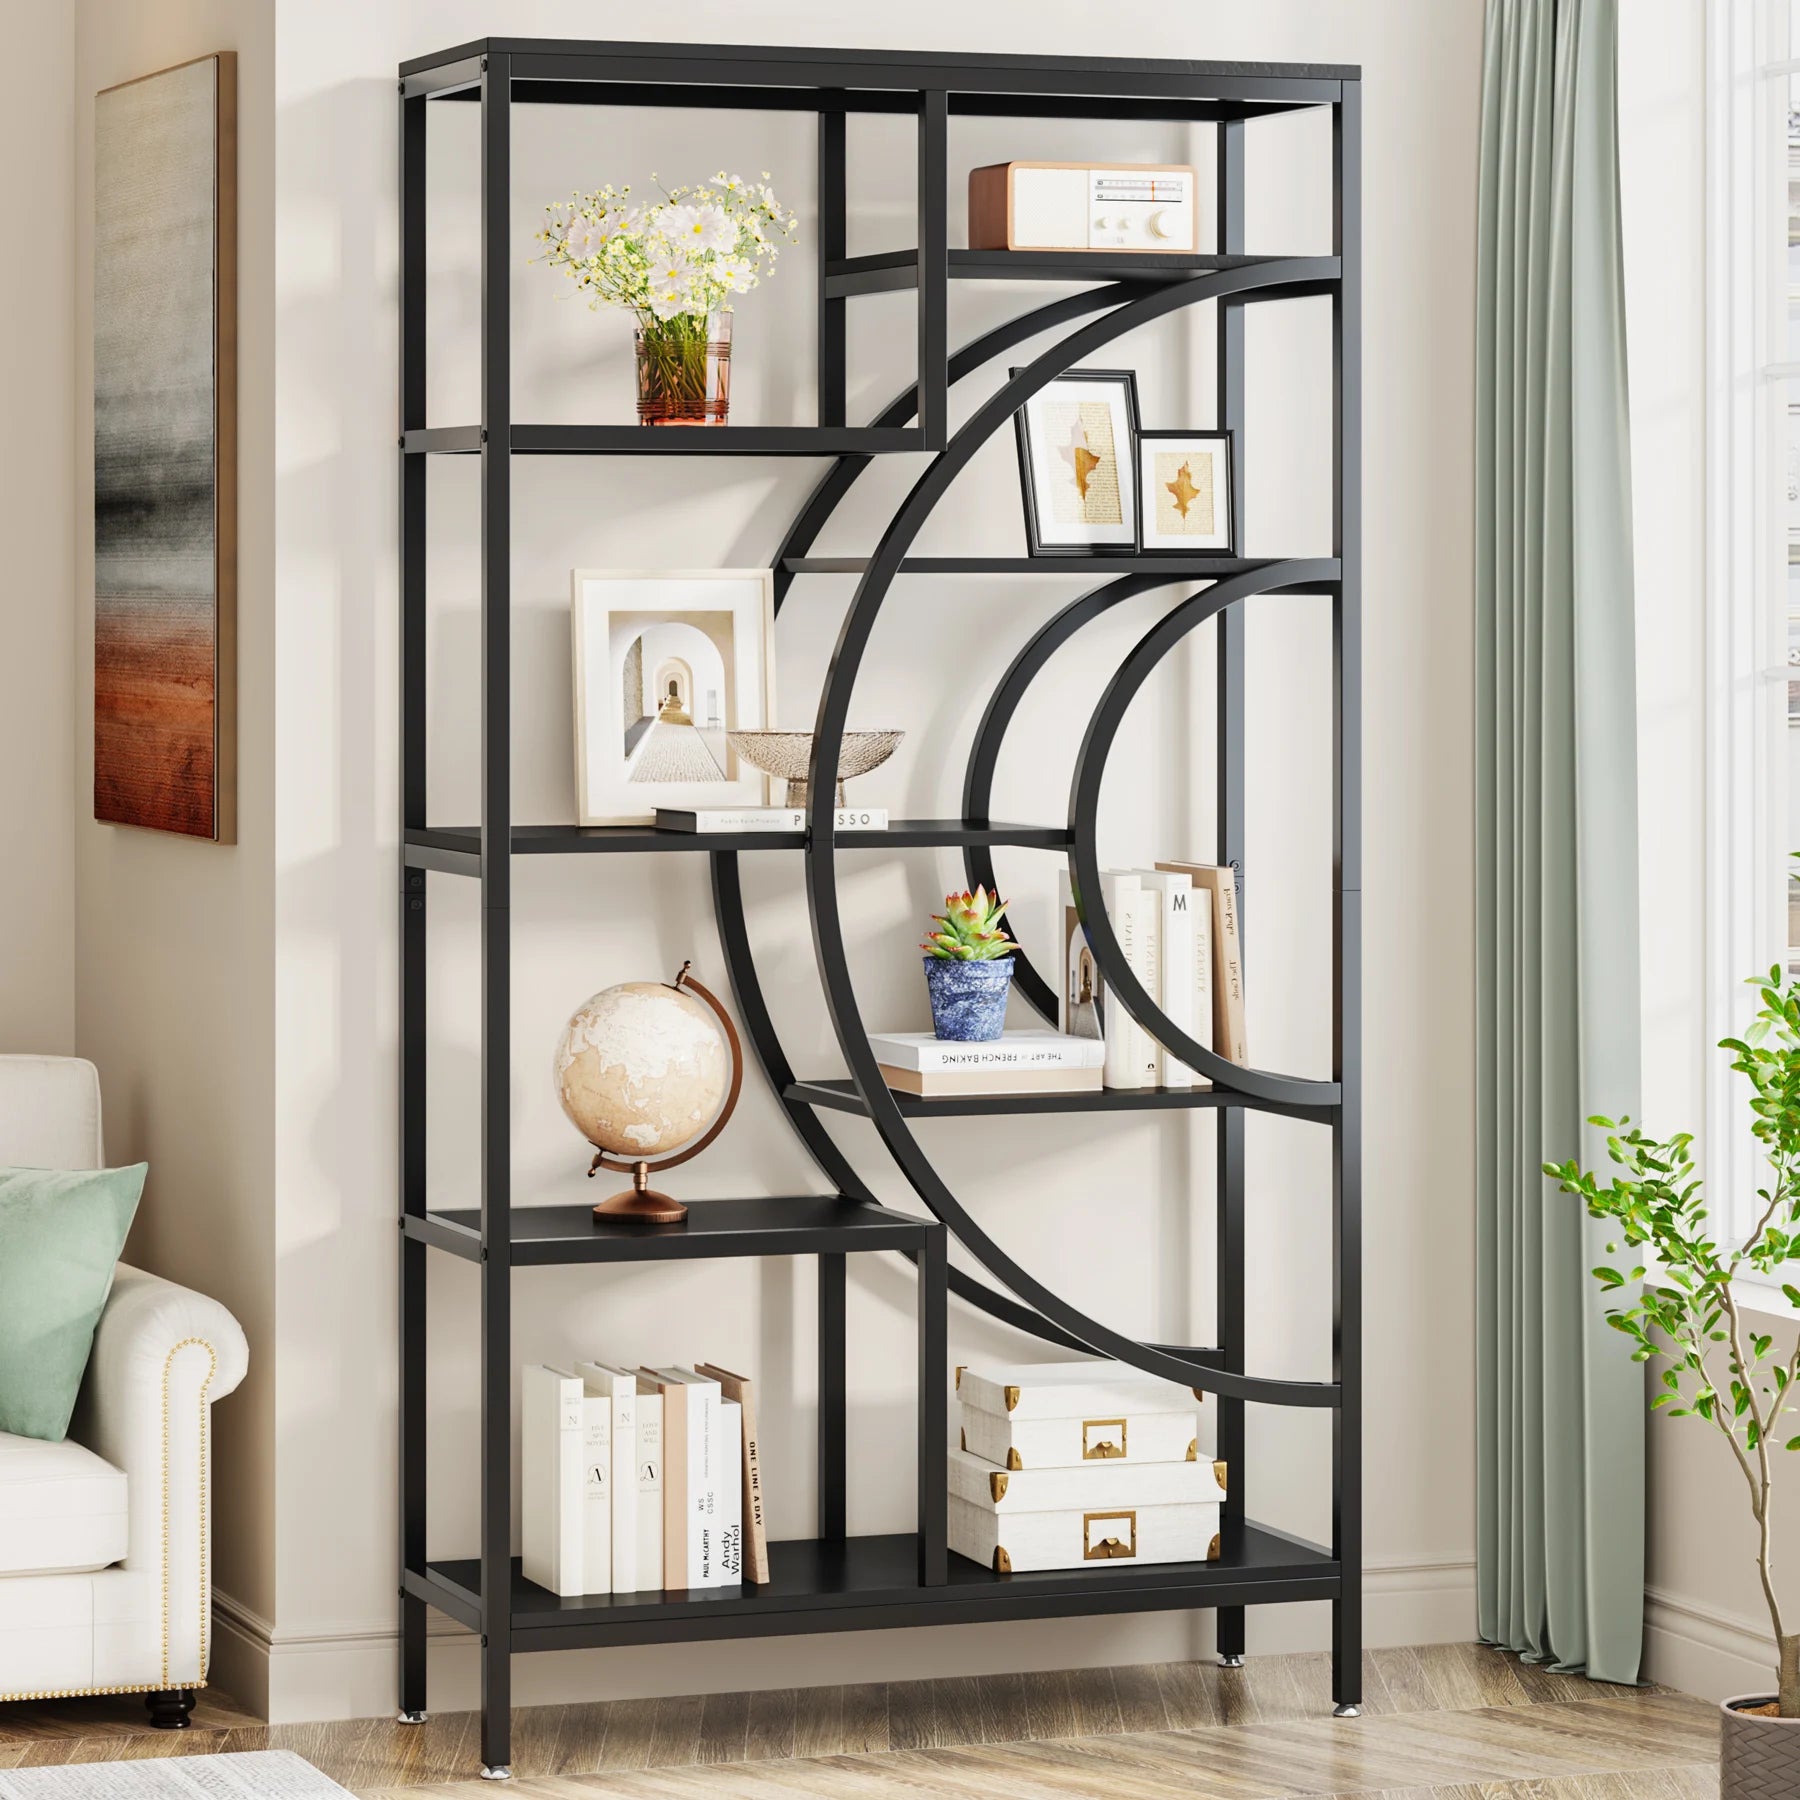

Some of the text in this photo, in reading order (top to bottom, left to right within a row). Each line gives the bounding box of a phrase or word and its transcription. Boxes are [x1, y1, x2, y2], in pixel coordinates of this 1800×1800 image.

[794, 814, 870, 826] PSSO
[1173, 894, 1187, 911] M
[941, 1054, 980, 1064] BAKING
[981, 1053, 1017, 1063] FRENCH
[1031, 1053, 1046, 1061] ART
[1047, 1053, 1062, 1061] THE
[749, 1441, 757, 1462] ONE
[751, 1467, 760, 1491] LINE
[698, 1497, 704, 1511] WS
[754, 1506, 762, 1526] DAY
[722, 1531, 733, 1569] Andy
[731, 1524, 740, 1575] Warhol
